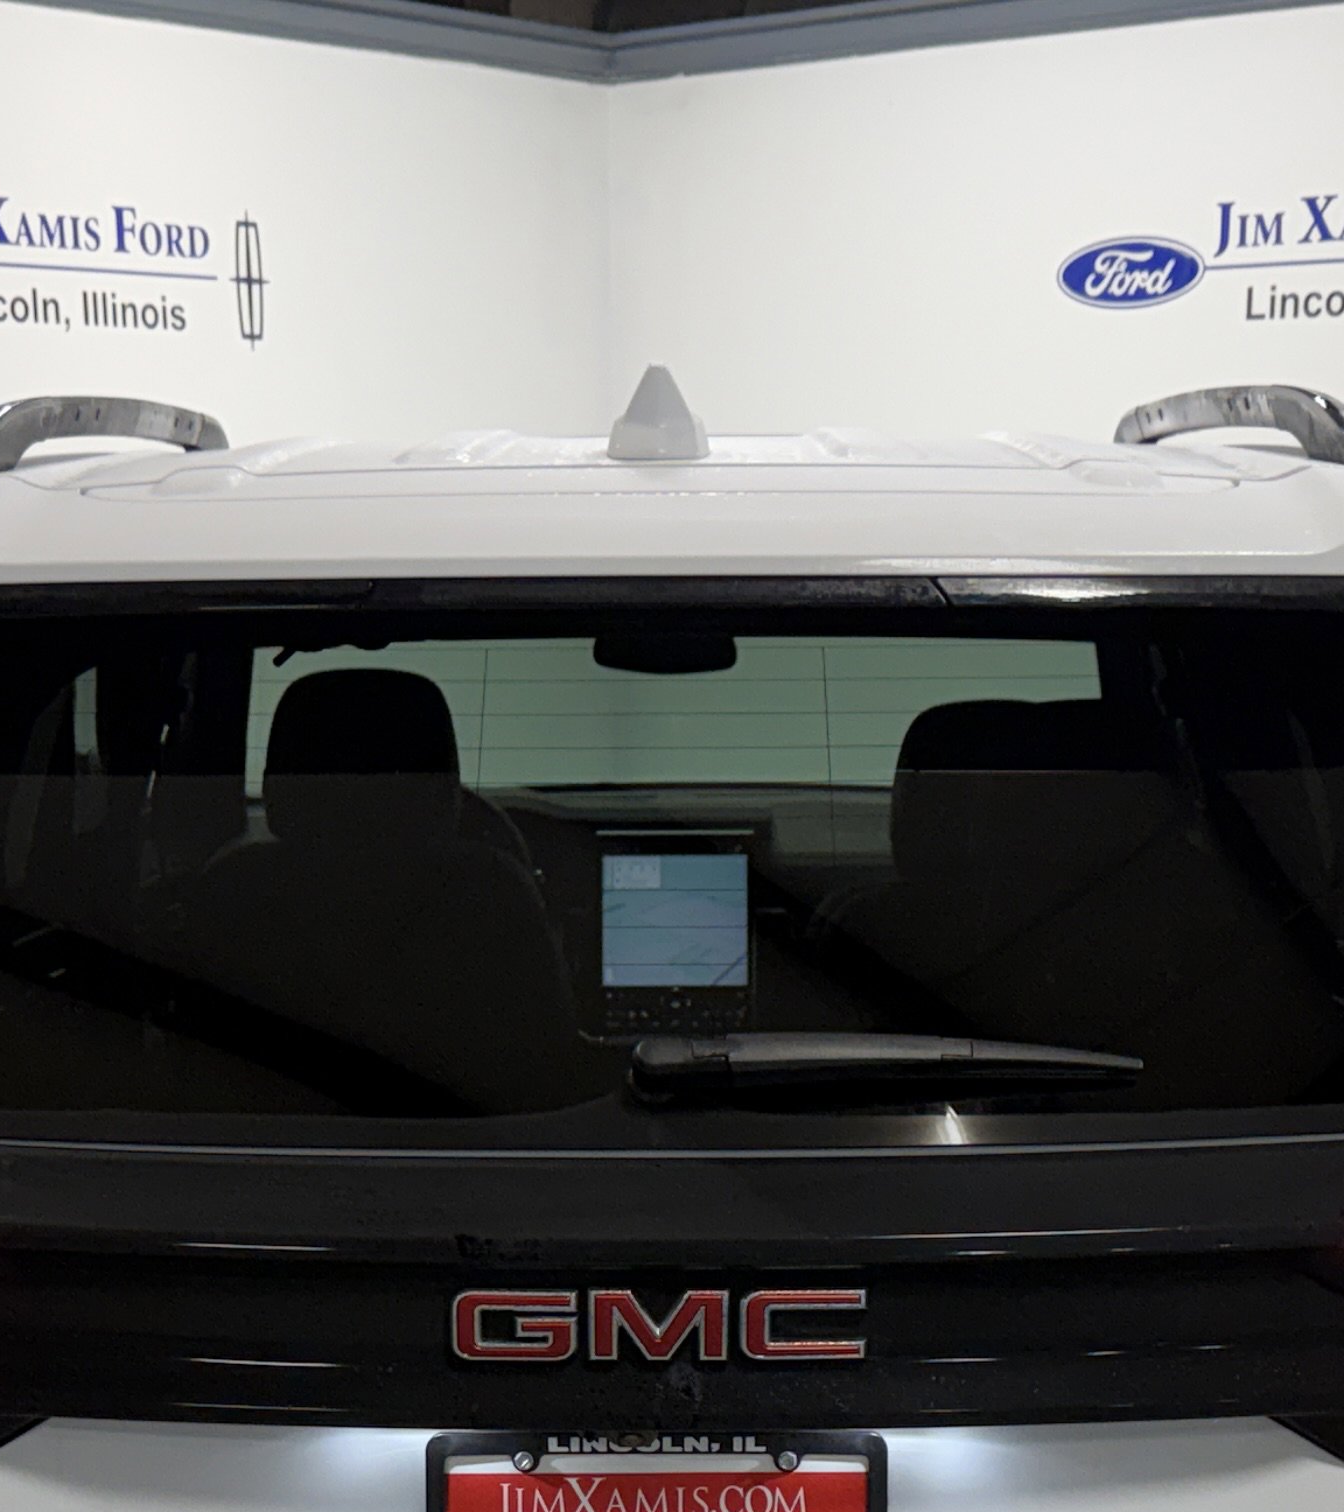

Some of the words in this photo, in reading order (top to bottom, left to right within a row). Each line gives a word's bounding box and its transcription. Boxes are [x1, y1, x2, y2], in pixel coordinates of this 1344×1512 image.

[1085, 249, 1173, 296] Ford
[82, 291, 187, 331] Illinois
[452, 1289, 867, 1361] GMC
[733, 1436, 767, 1452] IL
